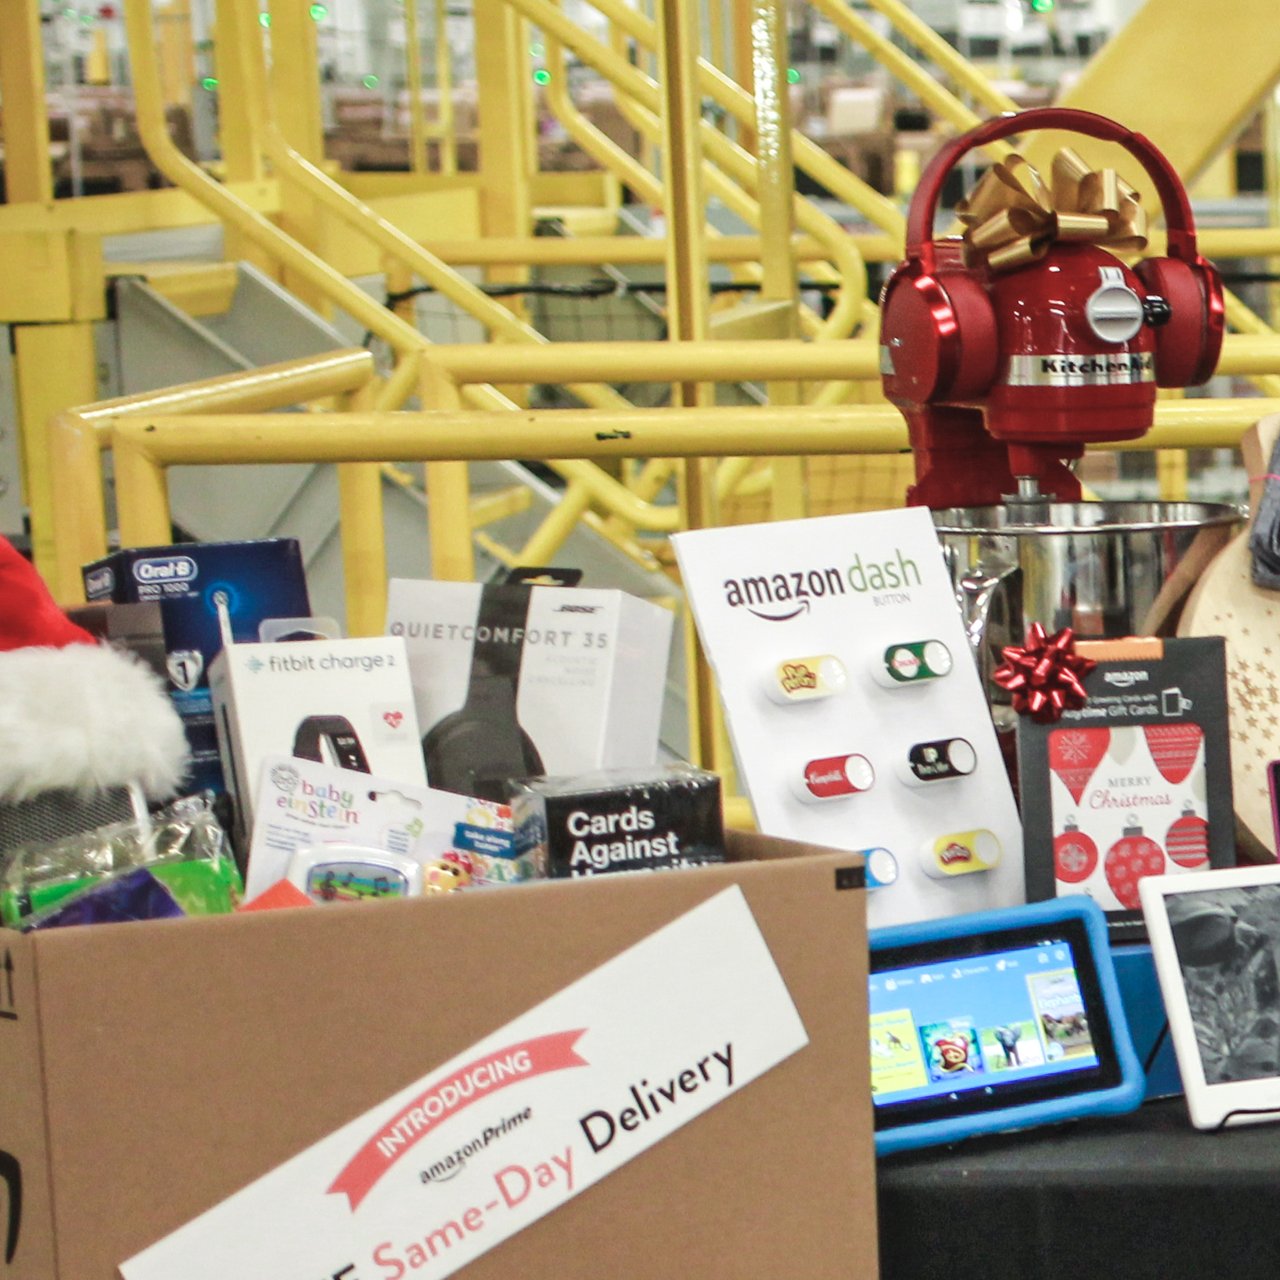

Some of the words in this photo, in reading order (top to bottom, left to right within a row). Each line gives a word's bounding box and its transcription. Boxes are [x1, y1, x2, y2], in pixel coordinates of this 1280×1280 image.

[723, 566, 846, 607] amazon
[848, 548, 922, 594] dash
[390, 621, 571, 647] QUIETCOMFORT
[583, 632, 608, 648] 35
[269, 656, 316, 672] fitbit
[319, 654, 384, 672] charge
[301, 780, 354, 809] baby
[1108, 776, 1151, 788] MERRY
[276, 793, 361, 825] einstein
[1089, 790, 1172, 809] Christmas
[566, 805, 656, 837] Cards
[569, 831, 680, 870] Against
[376, 1049, 532, 1158] INTRODUCING
[578, 1041, 739, 1155] Delivery
